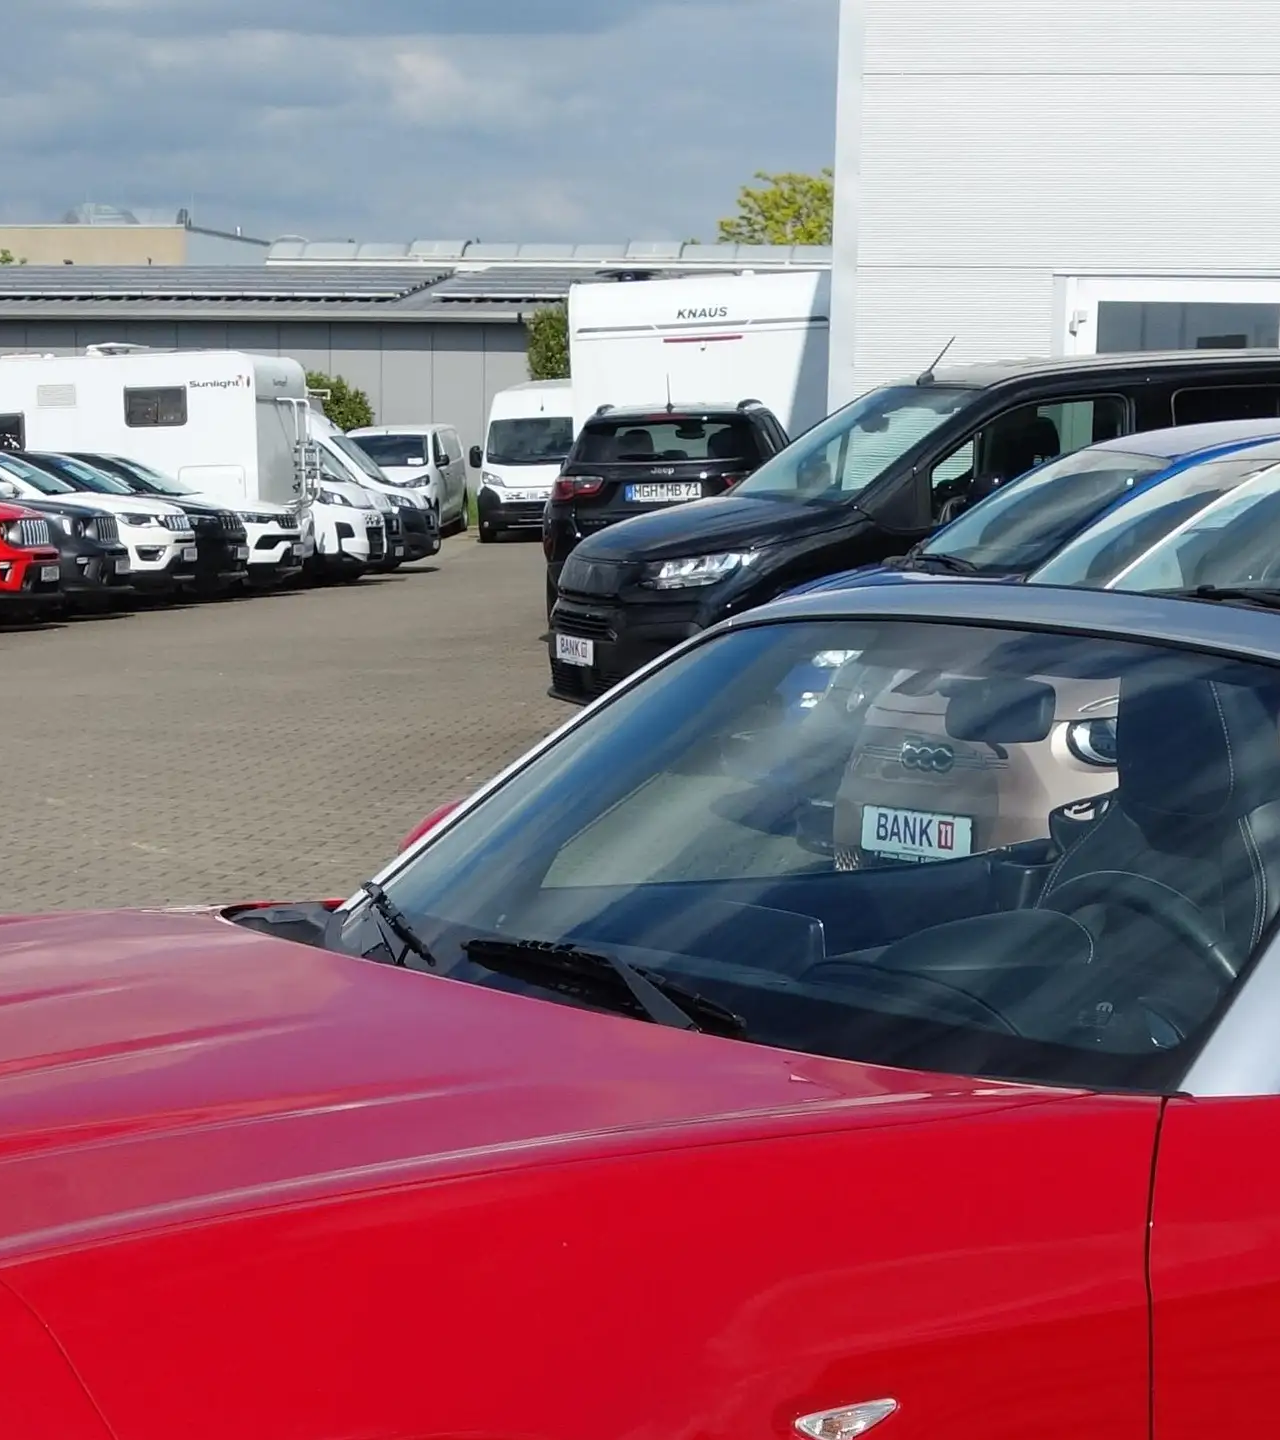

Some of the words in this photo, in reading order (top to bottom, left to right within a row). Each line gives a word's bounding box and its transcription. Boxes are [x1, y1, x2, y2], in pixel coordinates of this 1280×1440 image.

[676, 306, 728, 319] KNAUS
[189, 377, 240, 389] Sunlight
[650, 467, 675, 476] Jeep
[634, 484, 658, 499] MGH
[666, 483, 682, 497] MB
[686, 482, 700, 496] 71
[876, 813, 933, 848] BANK
